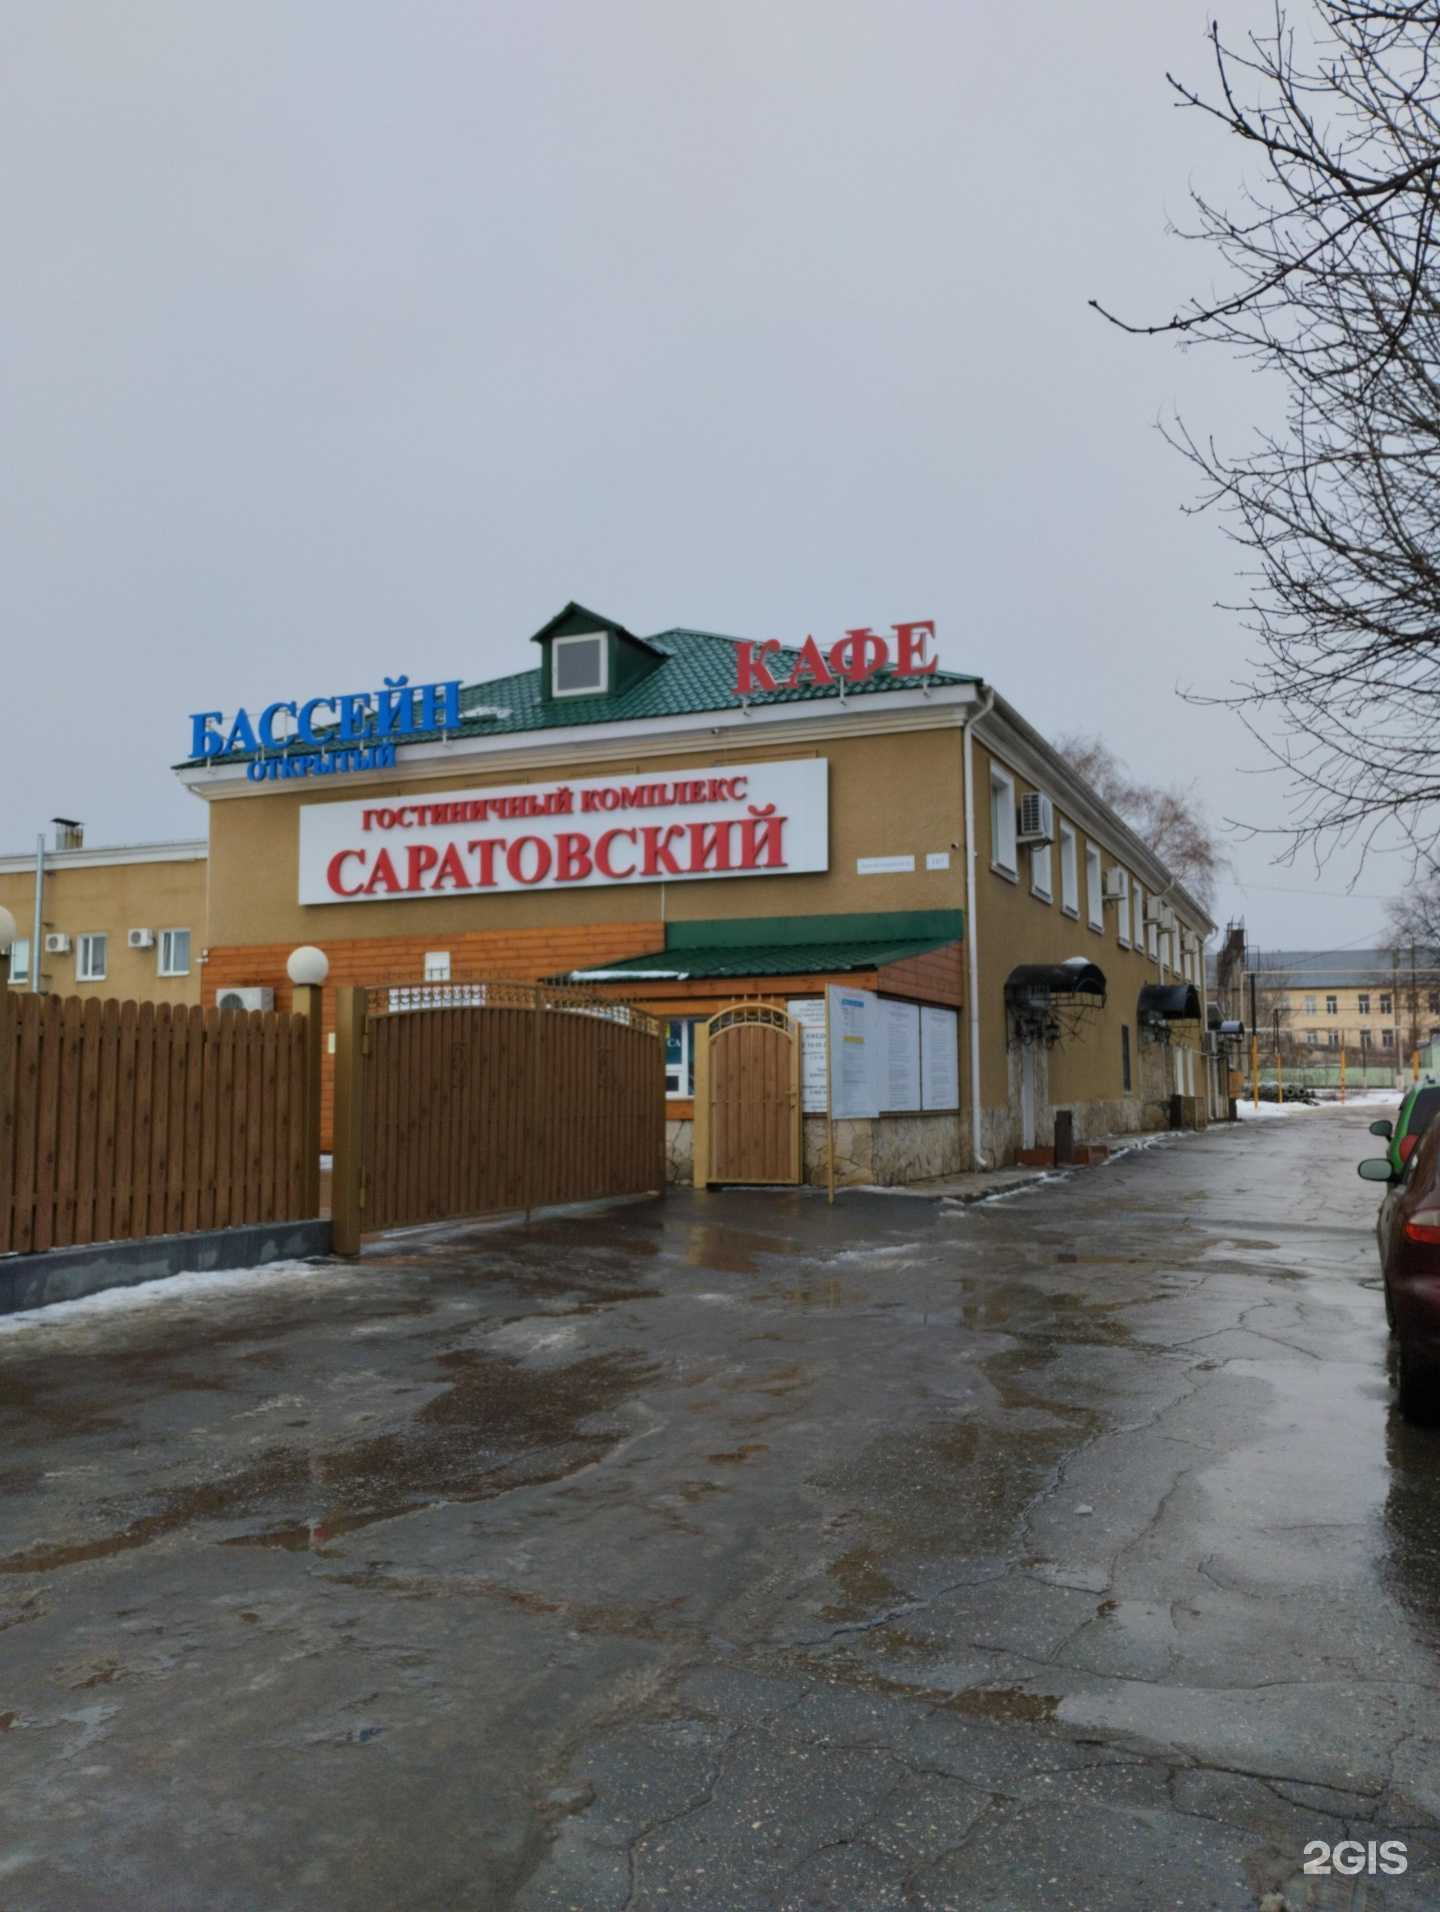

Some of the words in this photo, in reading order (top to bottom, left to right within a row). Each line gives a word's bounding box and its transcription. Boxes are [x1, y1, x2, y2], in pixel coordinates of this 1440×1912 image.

[734, 620, 938, 694] КАФЕ
[188, 675, 463, 758] БАССЕЙН
[247, 743, 397, 782] ОТКРЫТЫЙ
[362, 787, 573, 831] ГОСТИНИЧНЫЙ
[580, 776, 748, 813] КОМПЛЕКС
[327, 803, 788, 897] САРАТОВСКИЙ
